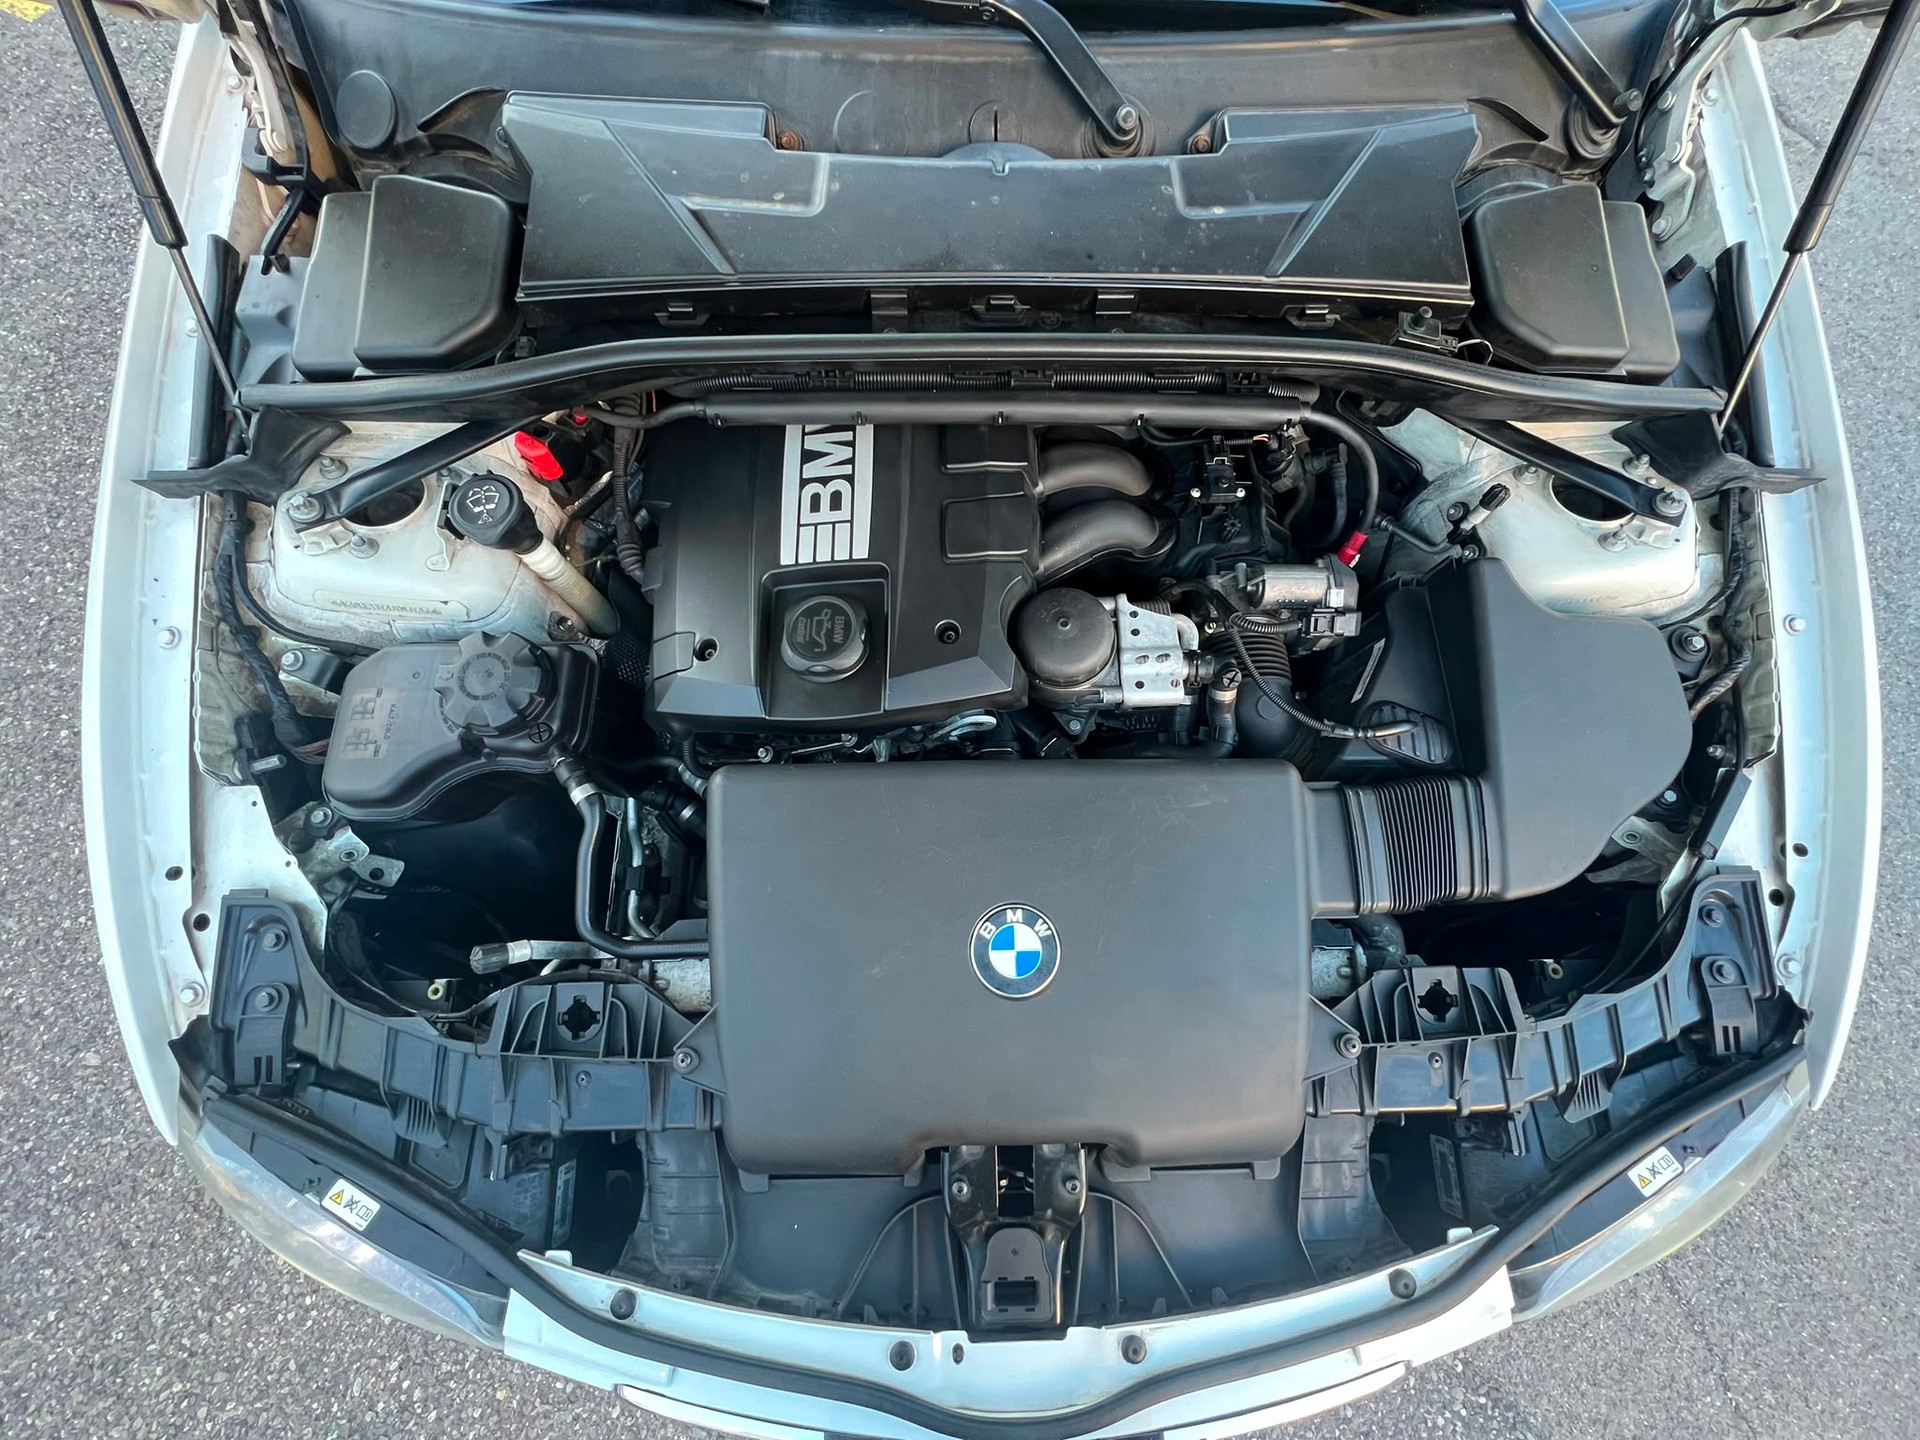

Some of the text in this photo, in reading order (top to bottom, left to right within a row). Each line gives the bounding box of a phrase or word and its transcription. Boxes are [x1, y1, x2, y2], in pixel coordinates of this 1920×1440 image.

[800, 424, 853, 524] BM
[833, 615, 845, 644] BMW
[979, 908, 1053, 940] BMW
